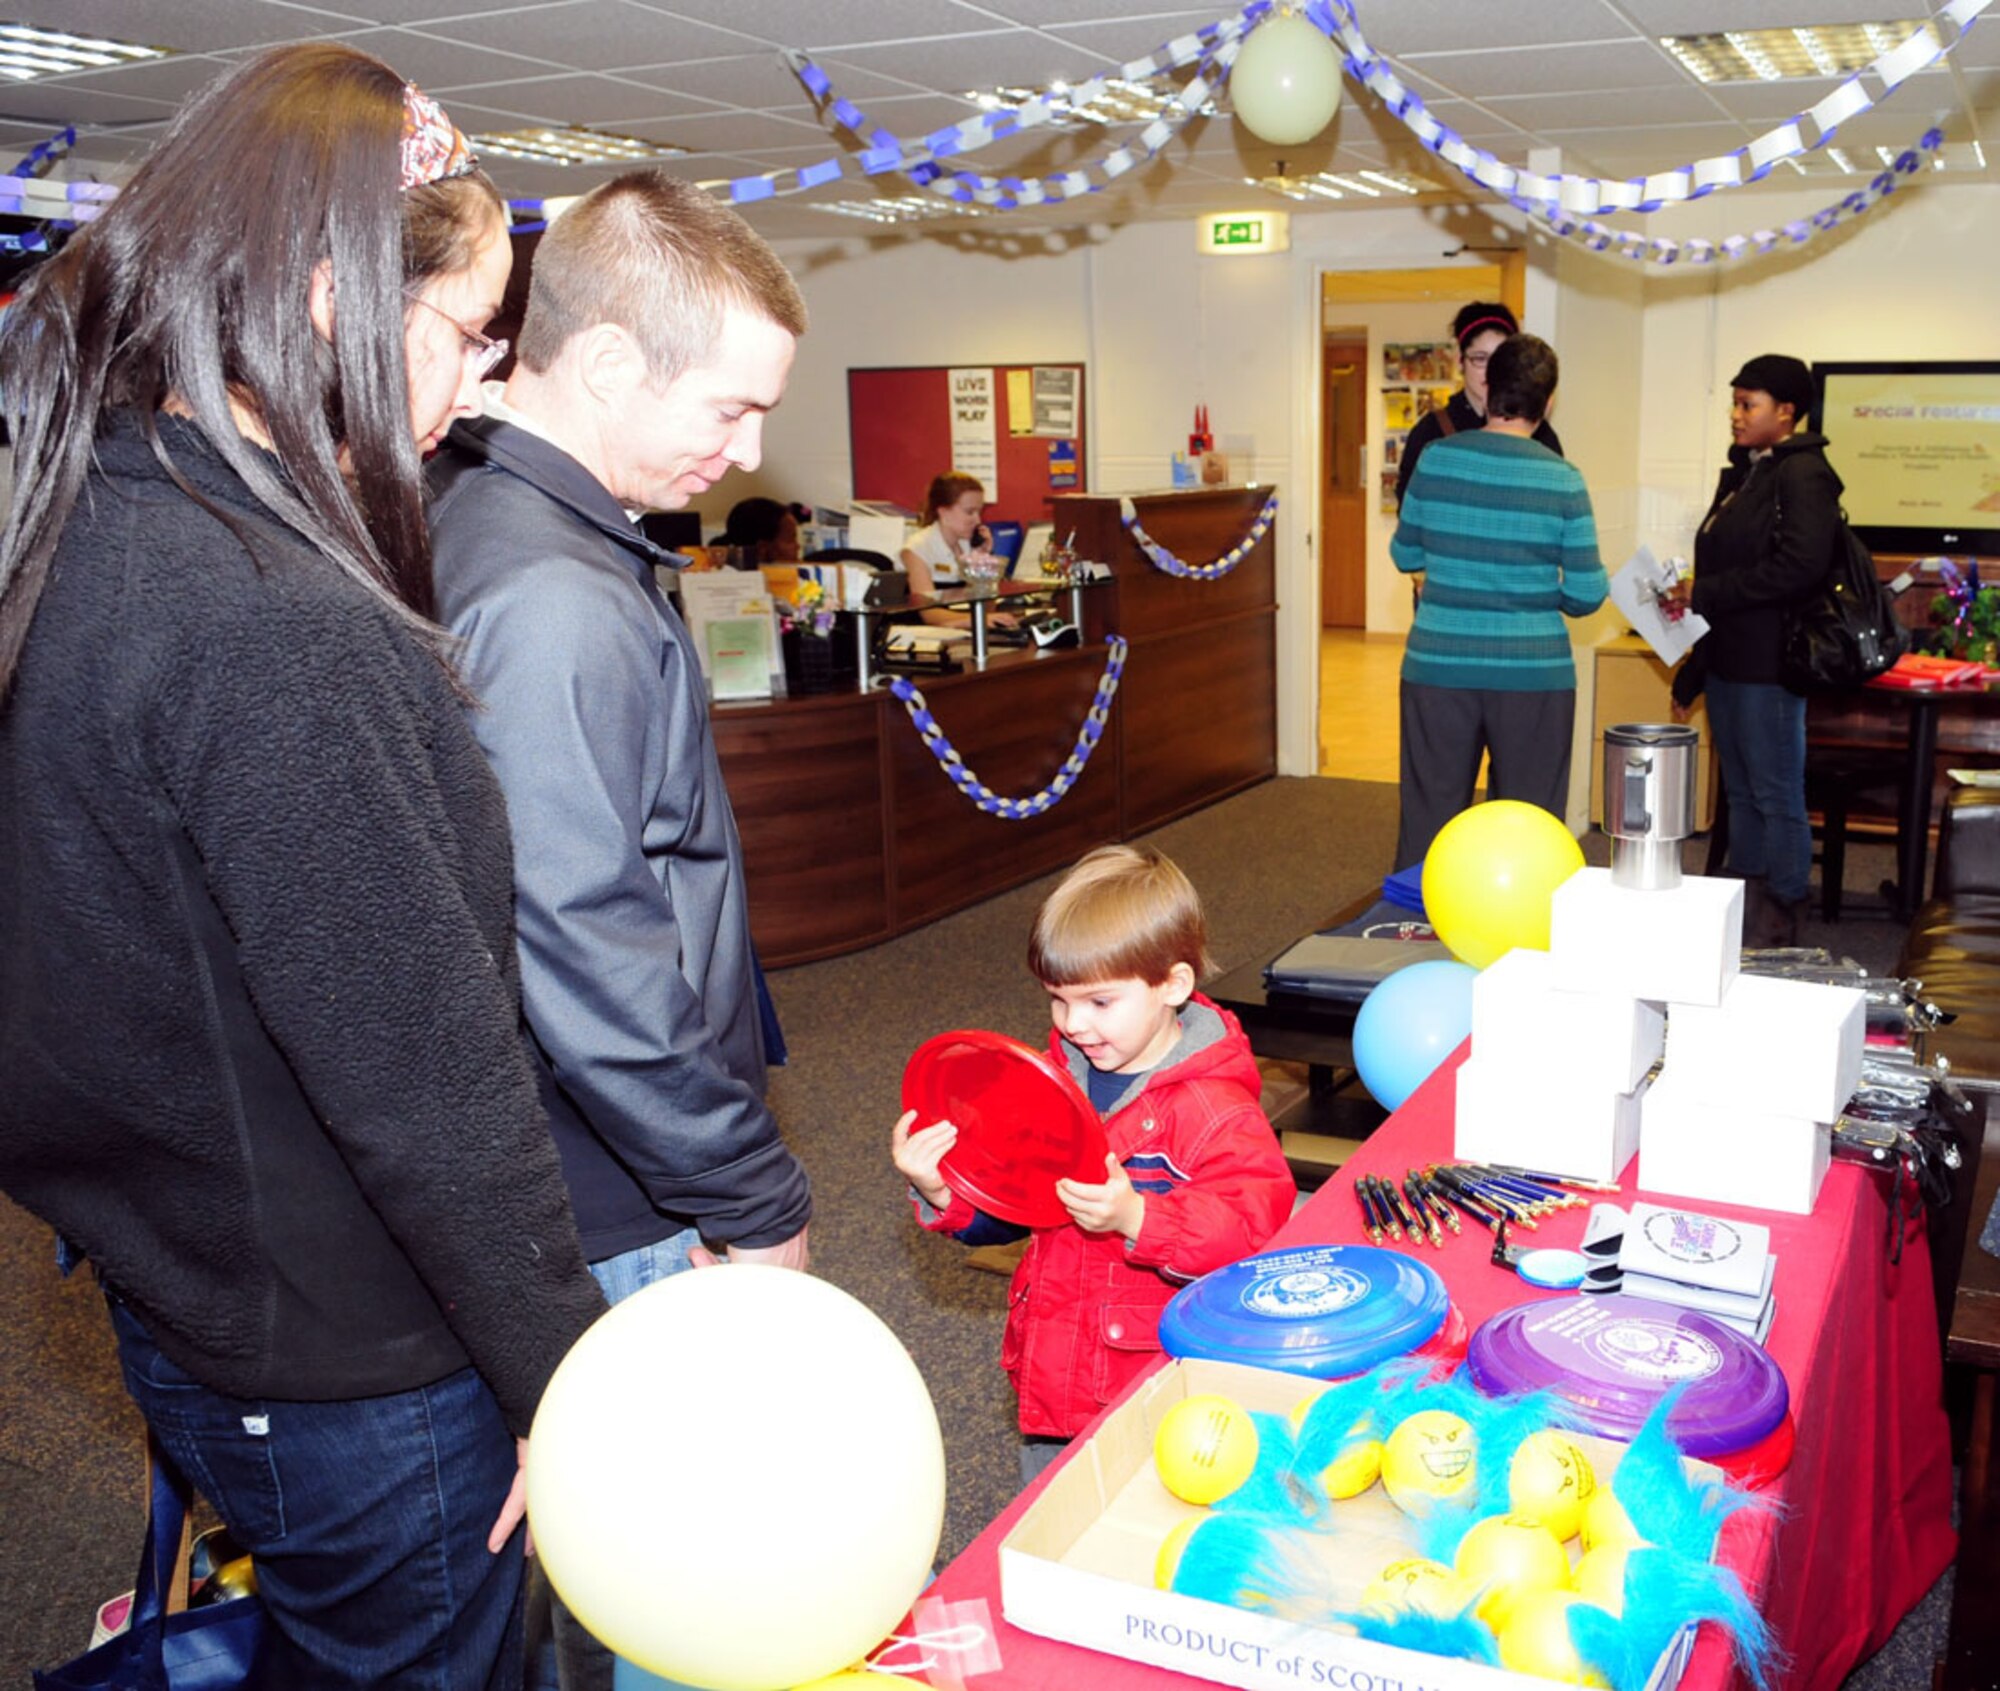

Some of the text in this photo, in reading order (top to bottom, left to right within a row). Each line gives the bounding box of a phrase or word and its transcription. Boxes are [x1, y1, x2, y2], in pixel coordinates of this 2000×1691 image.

[956, 377, 986, 391] LIVE
[953, 394, 988, 406] WORK
[957, 409, 986, 422] PLAY
[1125, 1614, 1440, 1691] PRODUCT of SCOT
